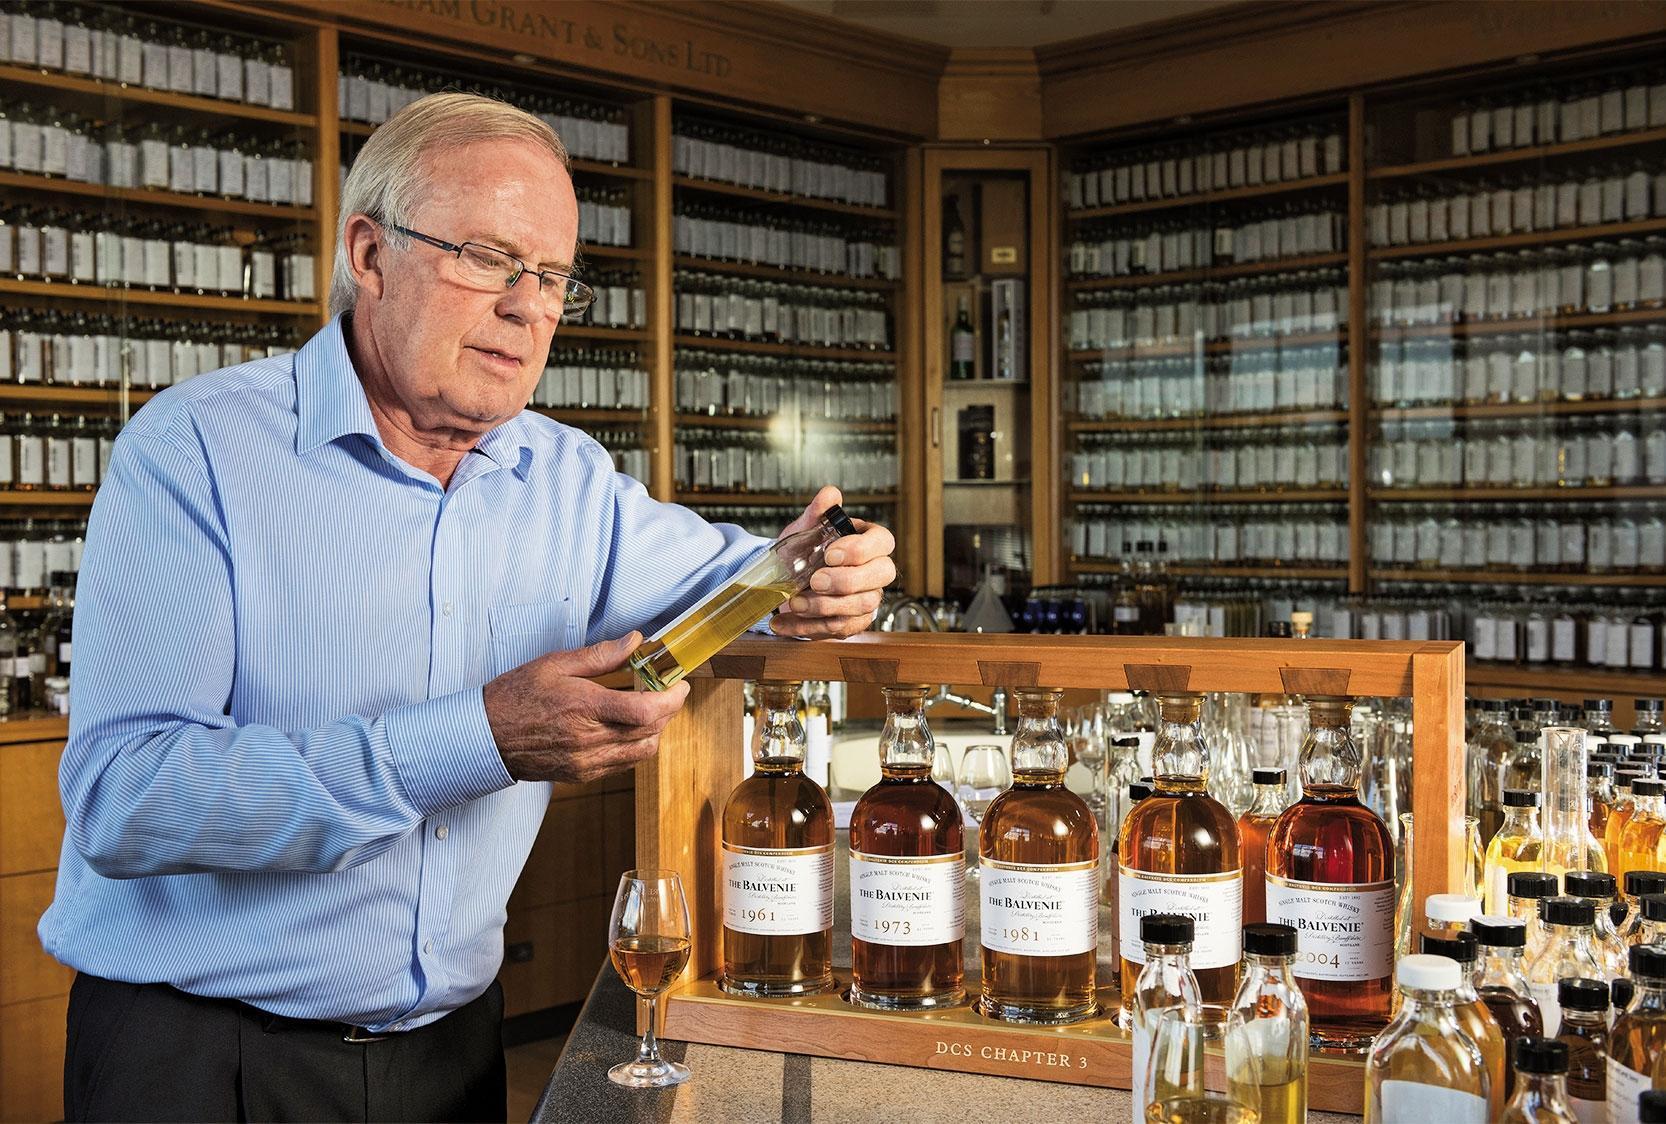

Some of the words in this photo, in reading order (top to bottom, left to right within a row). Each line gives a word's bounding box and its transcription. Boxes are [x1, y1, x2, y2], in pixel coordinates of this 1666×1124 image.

[471, 0, 575, 44] GRANT
[583, 30, 602, 50] &
[613, 24, 679, 67] SONS
[686, 41, 732, 78] LTD
[729, 880, 742, 889] THE
[743, 880, 796, 892] BALVENIE
[1017, 878, 1040, 886] SCOTCH
[860, 889, 874, 898] THE
[876, 889, 932, 901] BALVENIE
[1164, 889, 1187, 897] SCOTCH
[988, 896, 1002, 907] THE
[1005, 898, 1062, 910] BALVENIE
[1312, 898, 1336, 906] SCOTCH
[1338, 902, 1360, 914] WHISKY
[741, 908, 776, 922] 1961
[874, 920, 911, 934] 1973
[1278, 916, 1296, 928] THE
[1298, 918, 1361, 932] BALVENIE
[1003, 926, 1038, 942] 1981
[1297, 952, 1340, 968] 2004
[936, 1041, 972, 1056] DCS
[980, 1046, 1070, 1068] CHAPTER
[1079, 1056, 1088, 1069] 3
